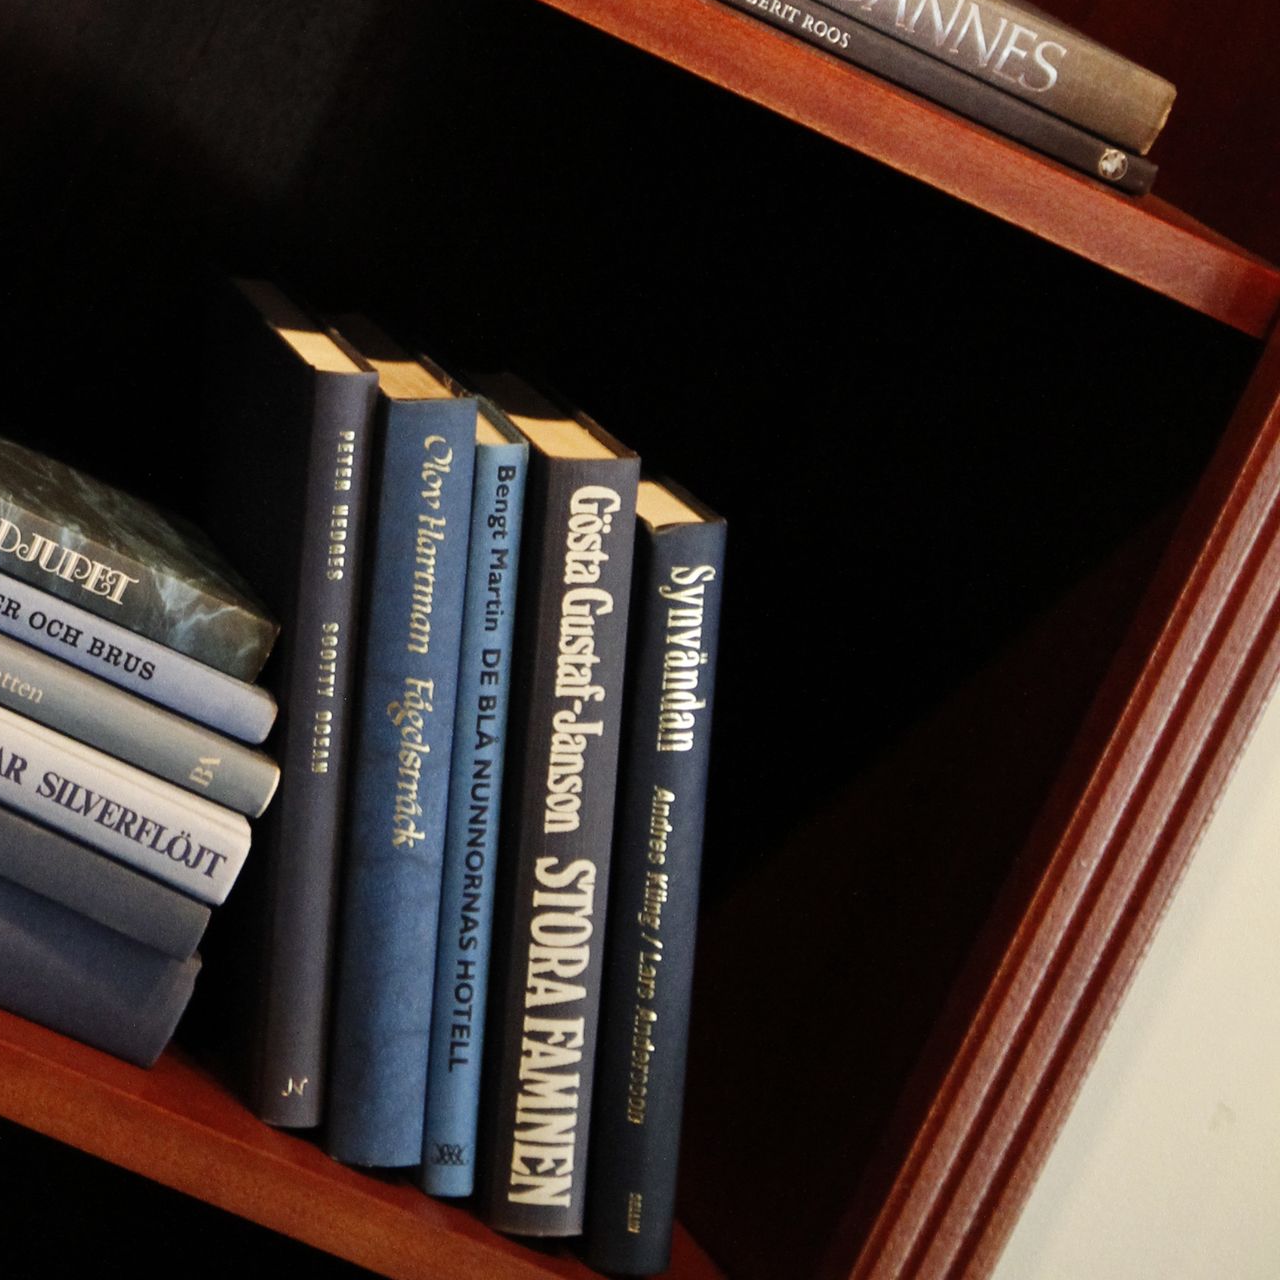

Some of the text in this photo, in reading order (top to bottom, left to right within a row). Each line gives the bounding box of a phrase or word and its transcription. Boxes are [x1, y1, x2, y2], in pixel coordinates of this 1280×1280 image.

[802, 14, 852, 49] ROOS
[326, 430, 356, 582] PETER HEDGES
[406, 434, 454, 655] Olov Hartman
[484, 464, 516, 632] Bengt Martin
[29, 611, 84, 648] OCH
[87, 636, 157, 681] BRUS
[311, 621, 340, 773] SCOTTY OCEAN
[544, 485, 621, 834] Gösta Gustaf-Janson
[657, 564, 716, 753] Synvändan
[35, 770, 228, 879] SILVERFLÖJT
[386, 677, 435, 849] Fågelsträck
[647, 785, 675, 865] Andres
[447, 648, 501, 1074] DE BLÅ NUNNORNAS HOTELL
[508, 855, 597, 1208] STORA FAMNEN
[637, 950, 662, 1000] Lars
[627, 1004, 657, 1125] Andersson
